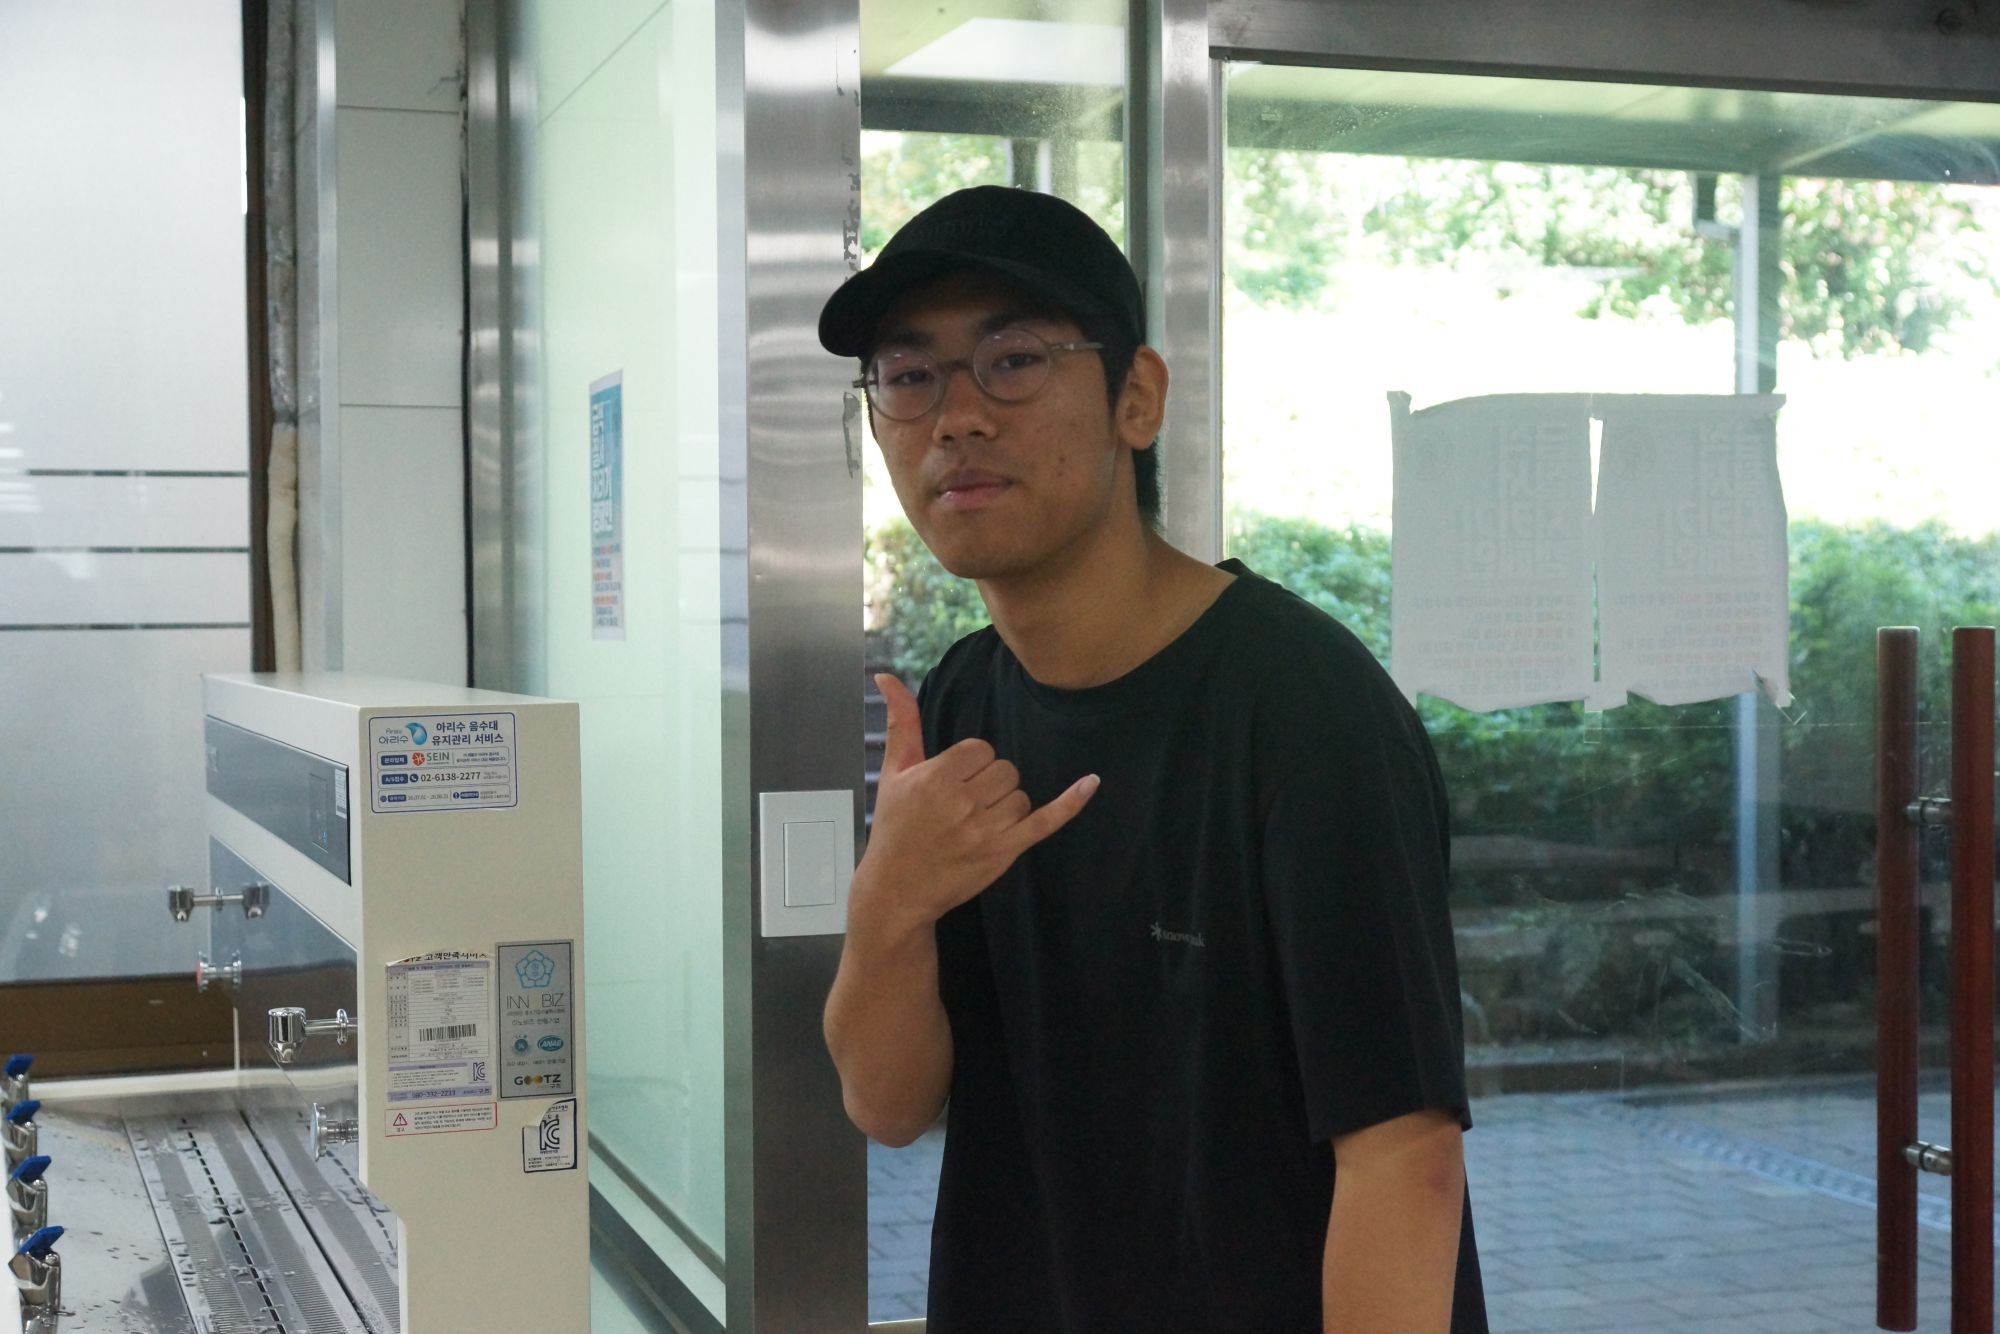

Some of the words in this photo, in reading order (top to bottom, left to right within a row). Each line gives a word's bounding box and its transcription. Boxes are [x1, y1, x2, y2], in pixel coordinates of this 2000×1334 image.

[436, 721, 466, 733] 아리수
[468, 720, 499, 732] 음수대
[378, 735, 409, 745] 아리수
[431, 735, 471, 746] 유지관리
[474, 733, 504, 745] 서비스
[426, 751, 450, 762] SEIN
[420, 771, 481, 782] 02-6138-2277
[424, 951, 489, 961] 고객만족서비스
